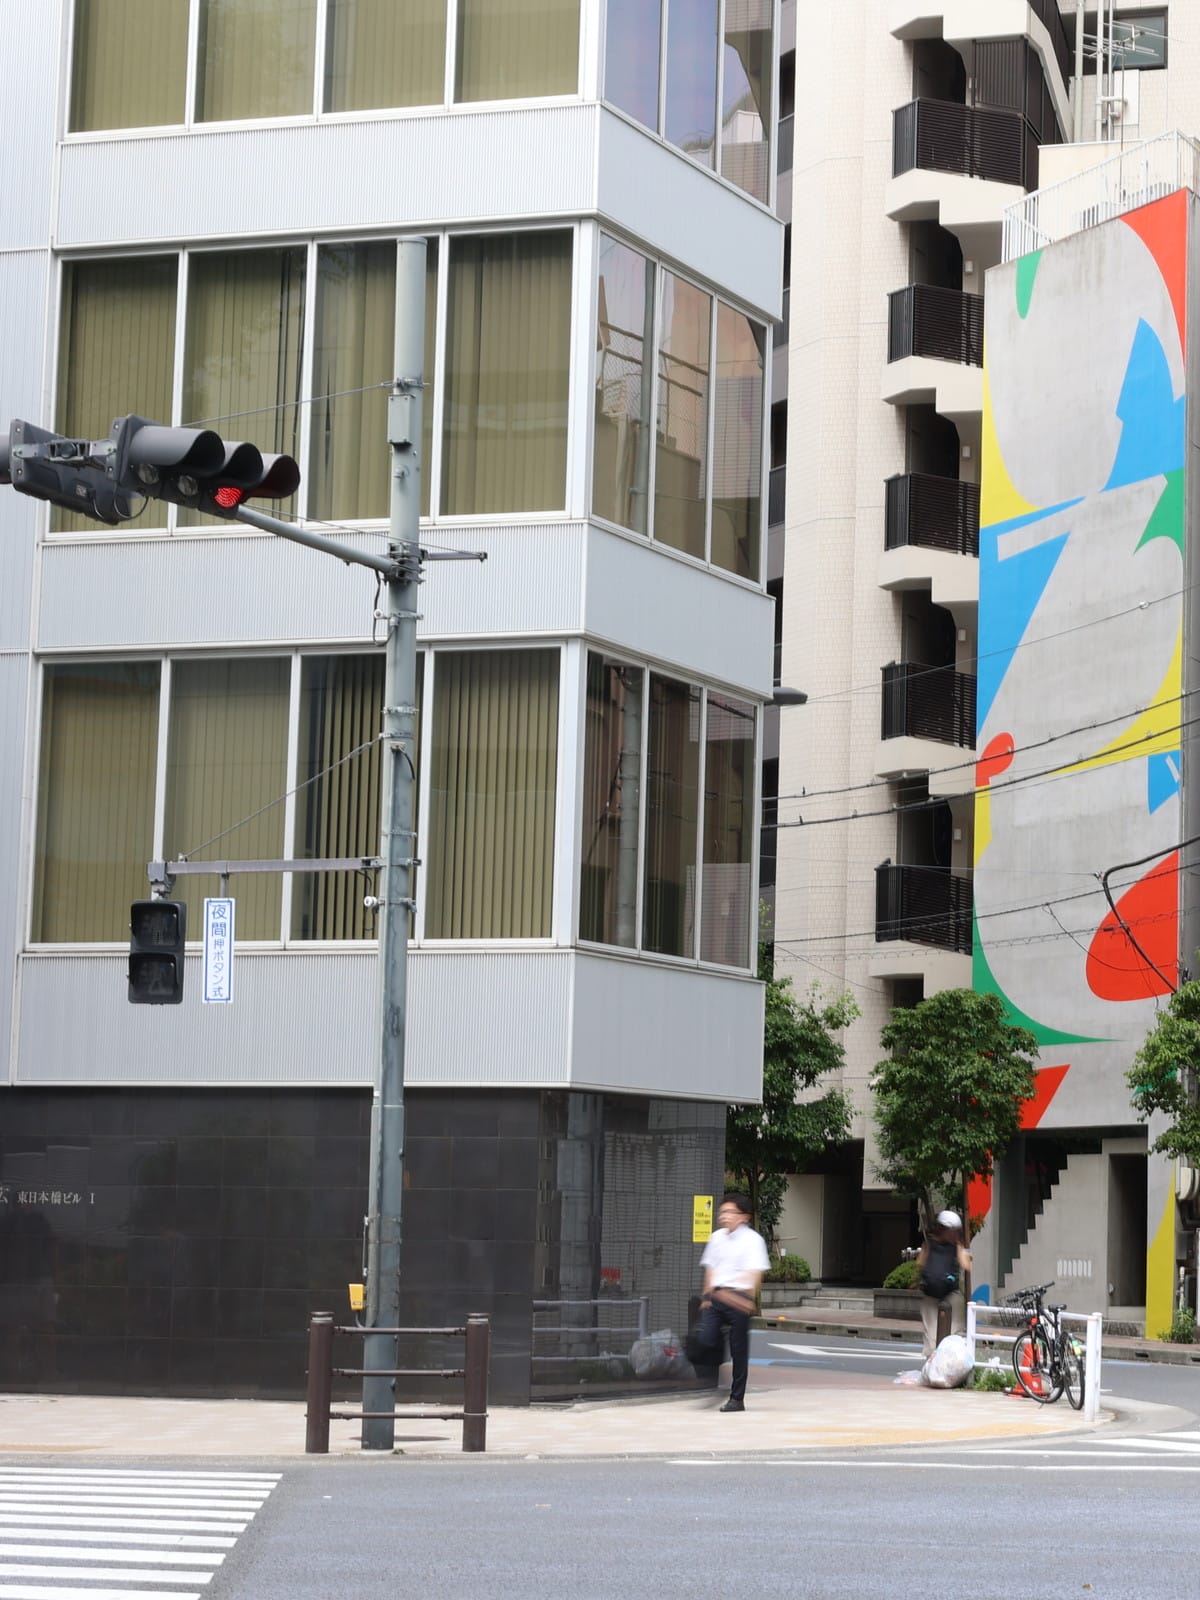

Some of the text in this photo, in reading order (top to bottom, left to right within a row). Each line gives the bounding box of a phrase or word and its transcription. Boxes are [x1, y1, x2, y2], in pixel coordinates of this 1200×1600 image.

[211, 904, 227, 998] 夜間押ボタン式
[17, 1191, 81, 1205] 東日本橋ビル
